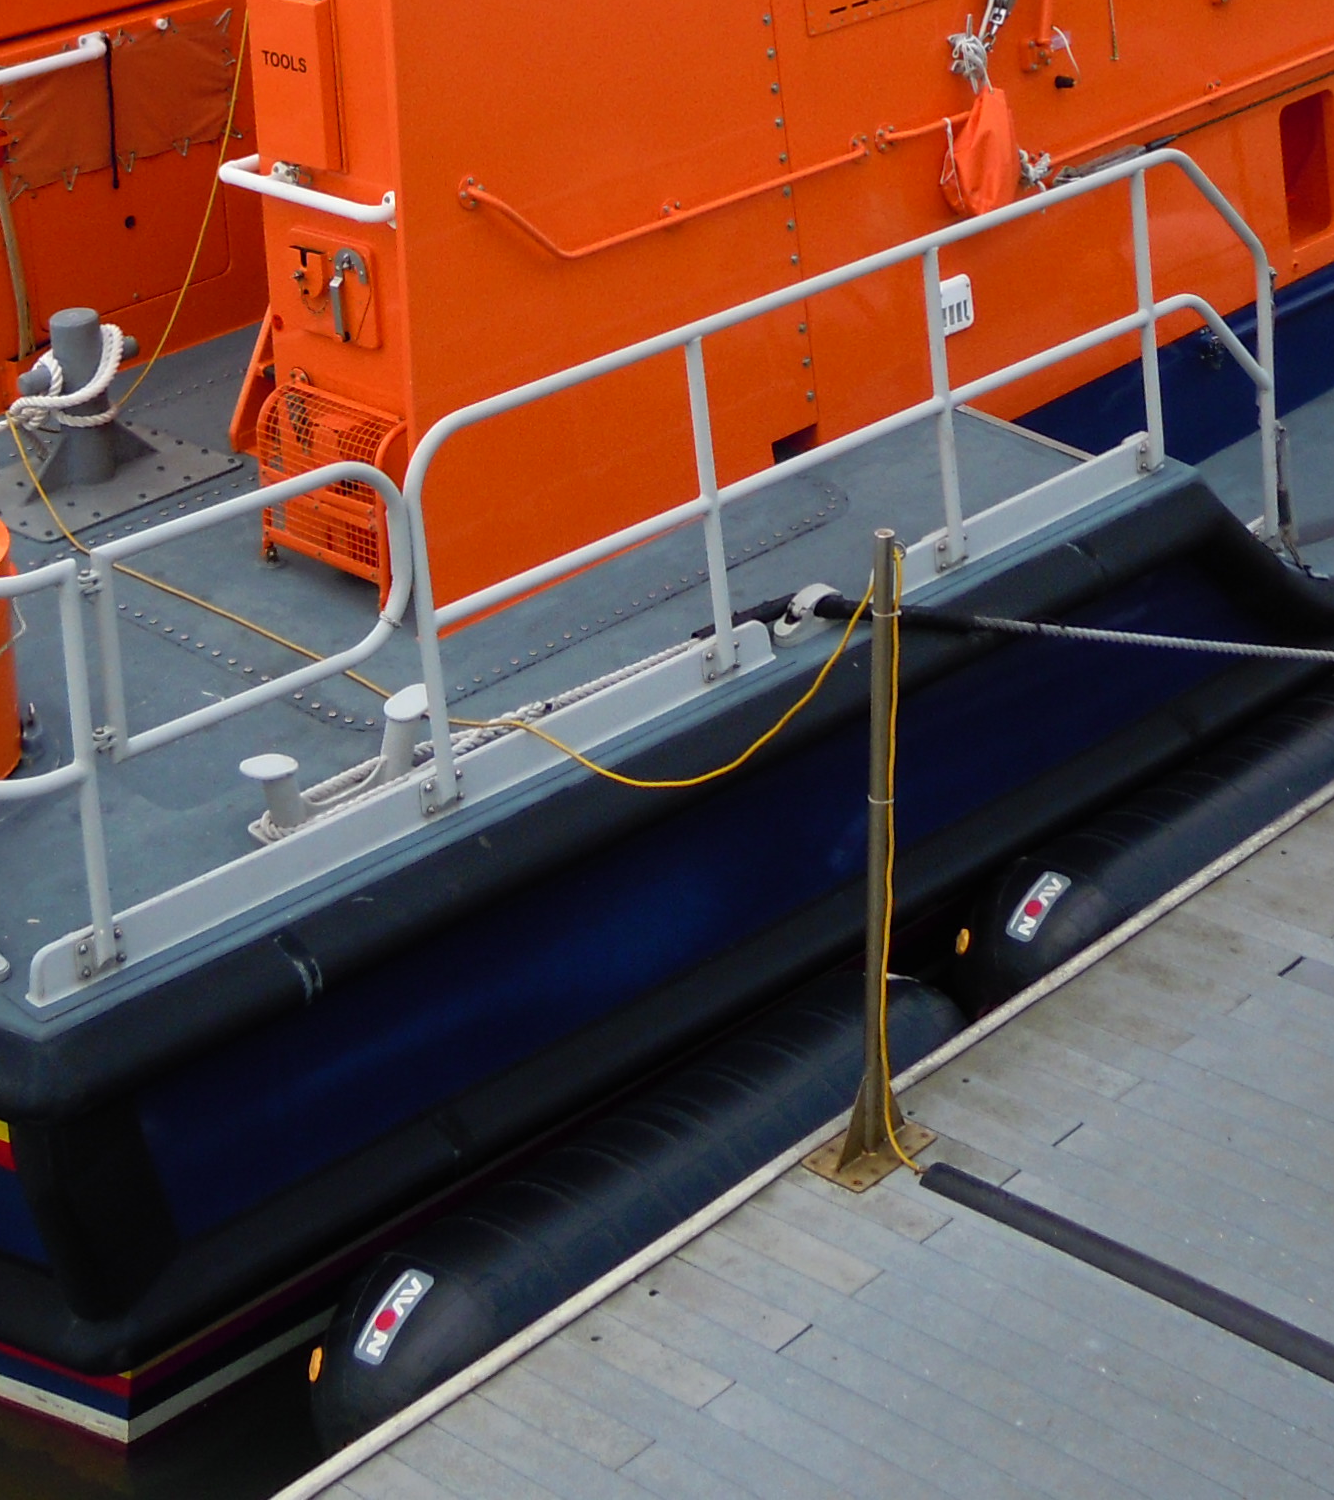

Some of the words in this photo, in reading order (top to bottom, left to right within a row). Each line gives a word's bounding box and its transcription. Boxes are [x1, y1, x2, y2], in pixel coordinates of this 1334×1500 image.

[261, 49, 307, 74] TOOLS
[1016, 876, 1063, 937] AVON
[365, 1275, 424, 1358] AVON
